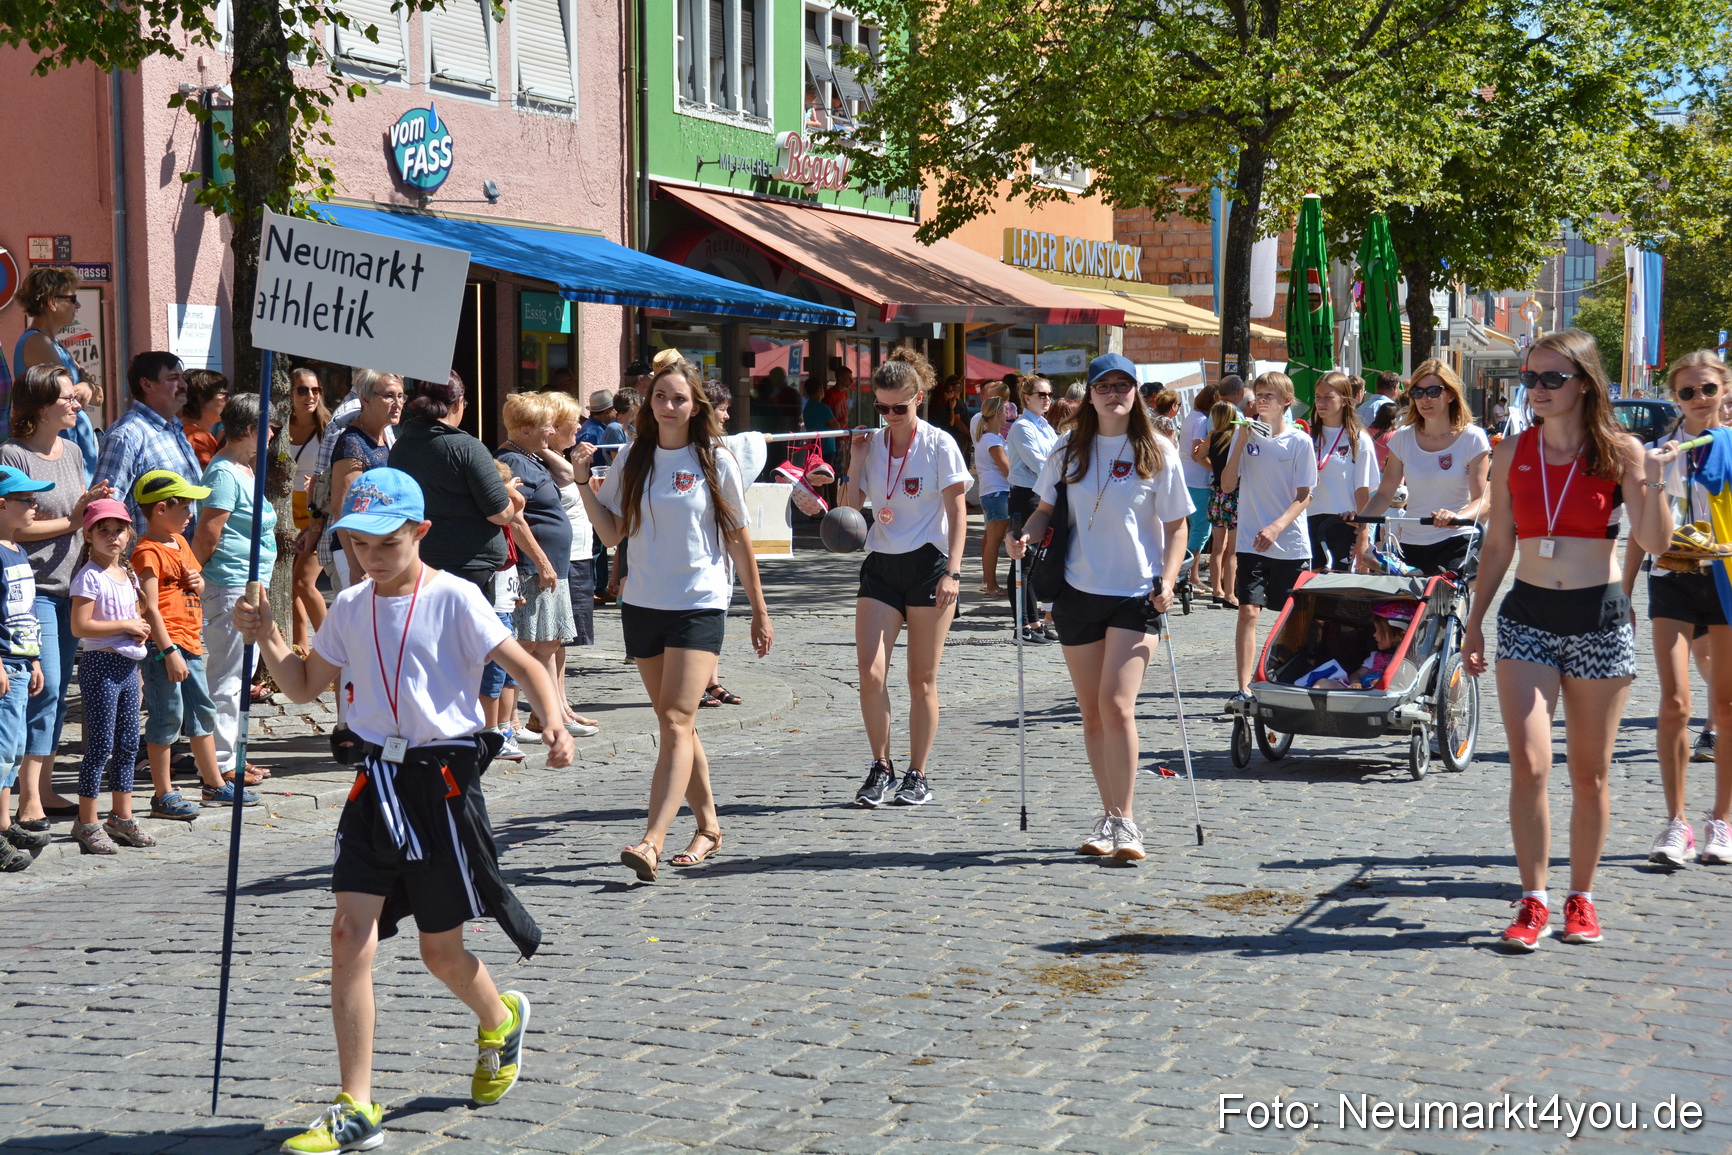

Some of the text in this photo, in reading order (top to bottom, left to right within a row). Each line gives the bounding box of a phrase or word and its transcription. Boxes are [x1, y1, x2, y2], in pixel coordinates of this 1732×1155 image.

[390, 116, 425, 147] vom
[402, 135, 453, 181] FASS
[781, 131, 851, 194] Bögerl
[265, 225, 424, 292] Neumarkt
[1013, 228, 1142, 281] LEDER ROMSTÖCK
[256, 277, 375, 339] athletik
[525, 303, 547, 325] Essig
